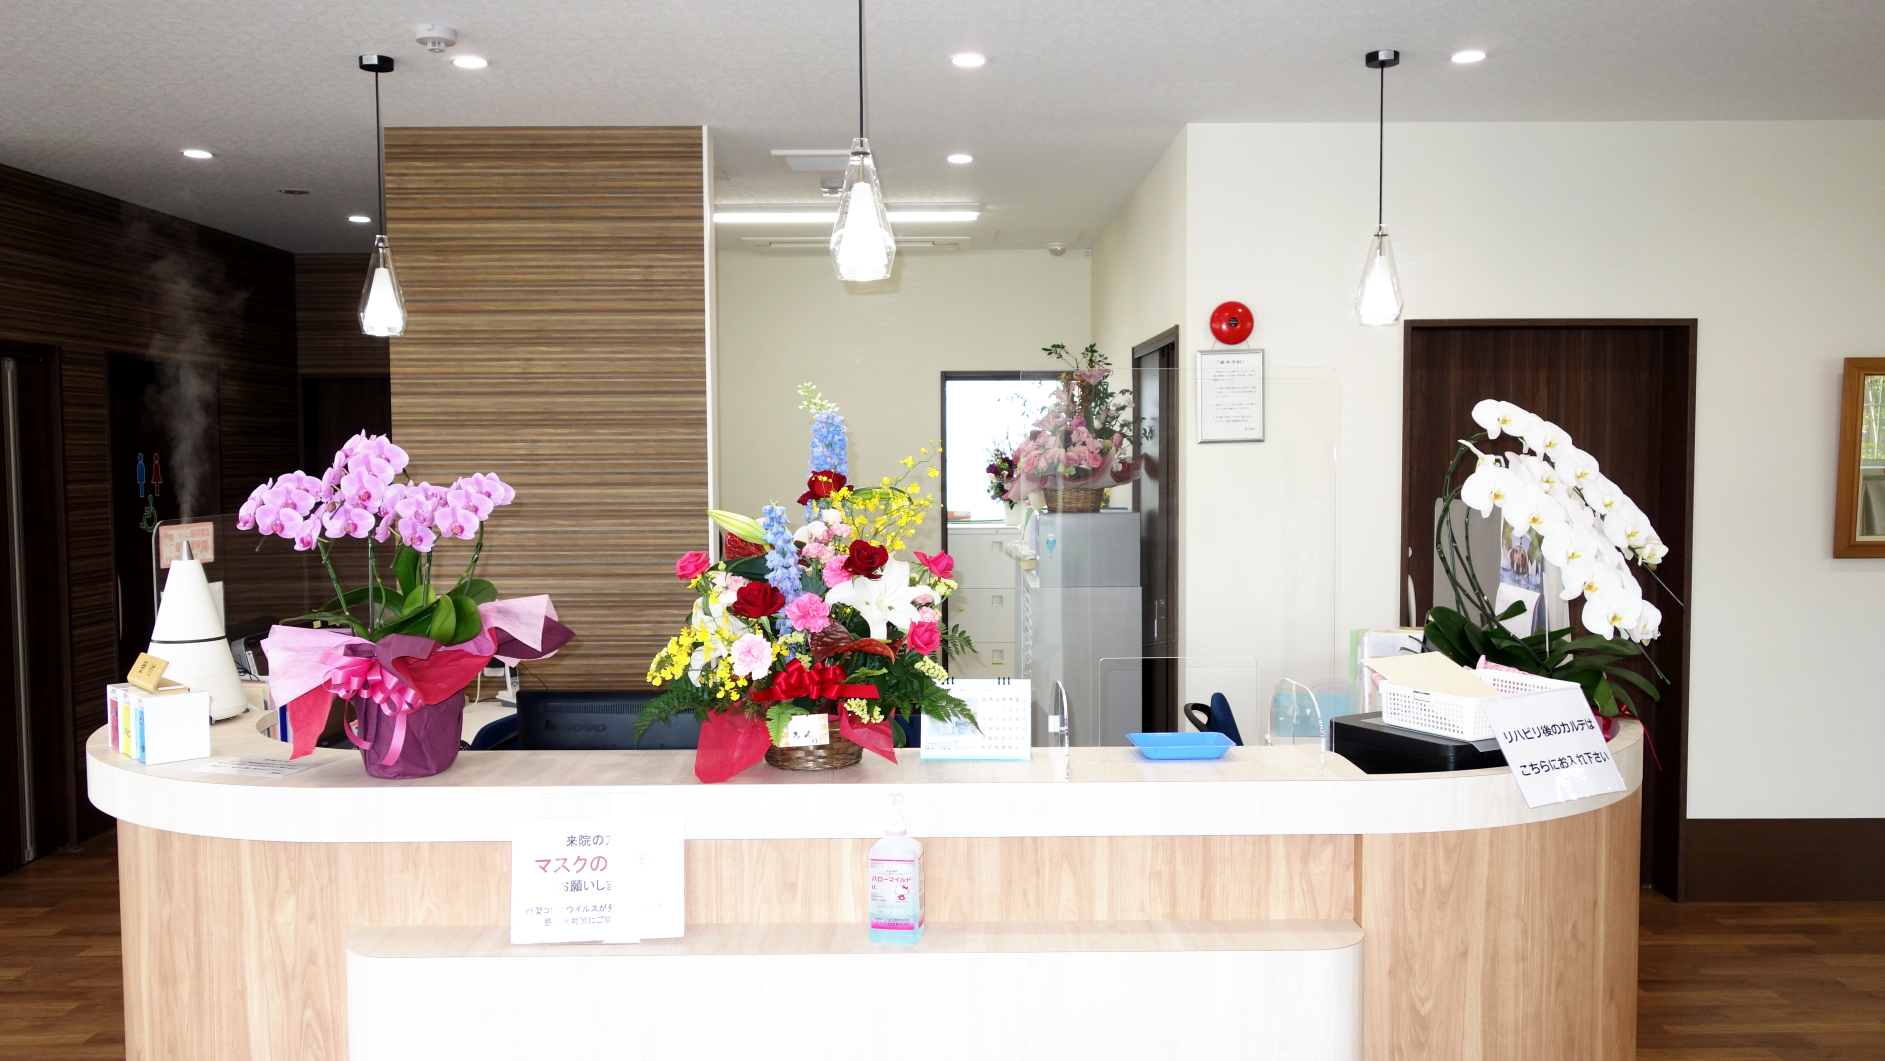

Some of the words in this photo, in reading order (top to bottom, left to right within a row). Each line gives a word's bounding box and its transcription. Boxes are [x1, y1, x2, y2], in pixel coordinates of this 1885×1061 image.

[544, 720, 607, 732] lenovo
[1503, 719, 1595, 743] リハビリ後のカルテは
[1520, 752, 1609, 776] こちらにお入れ下さい
